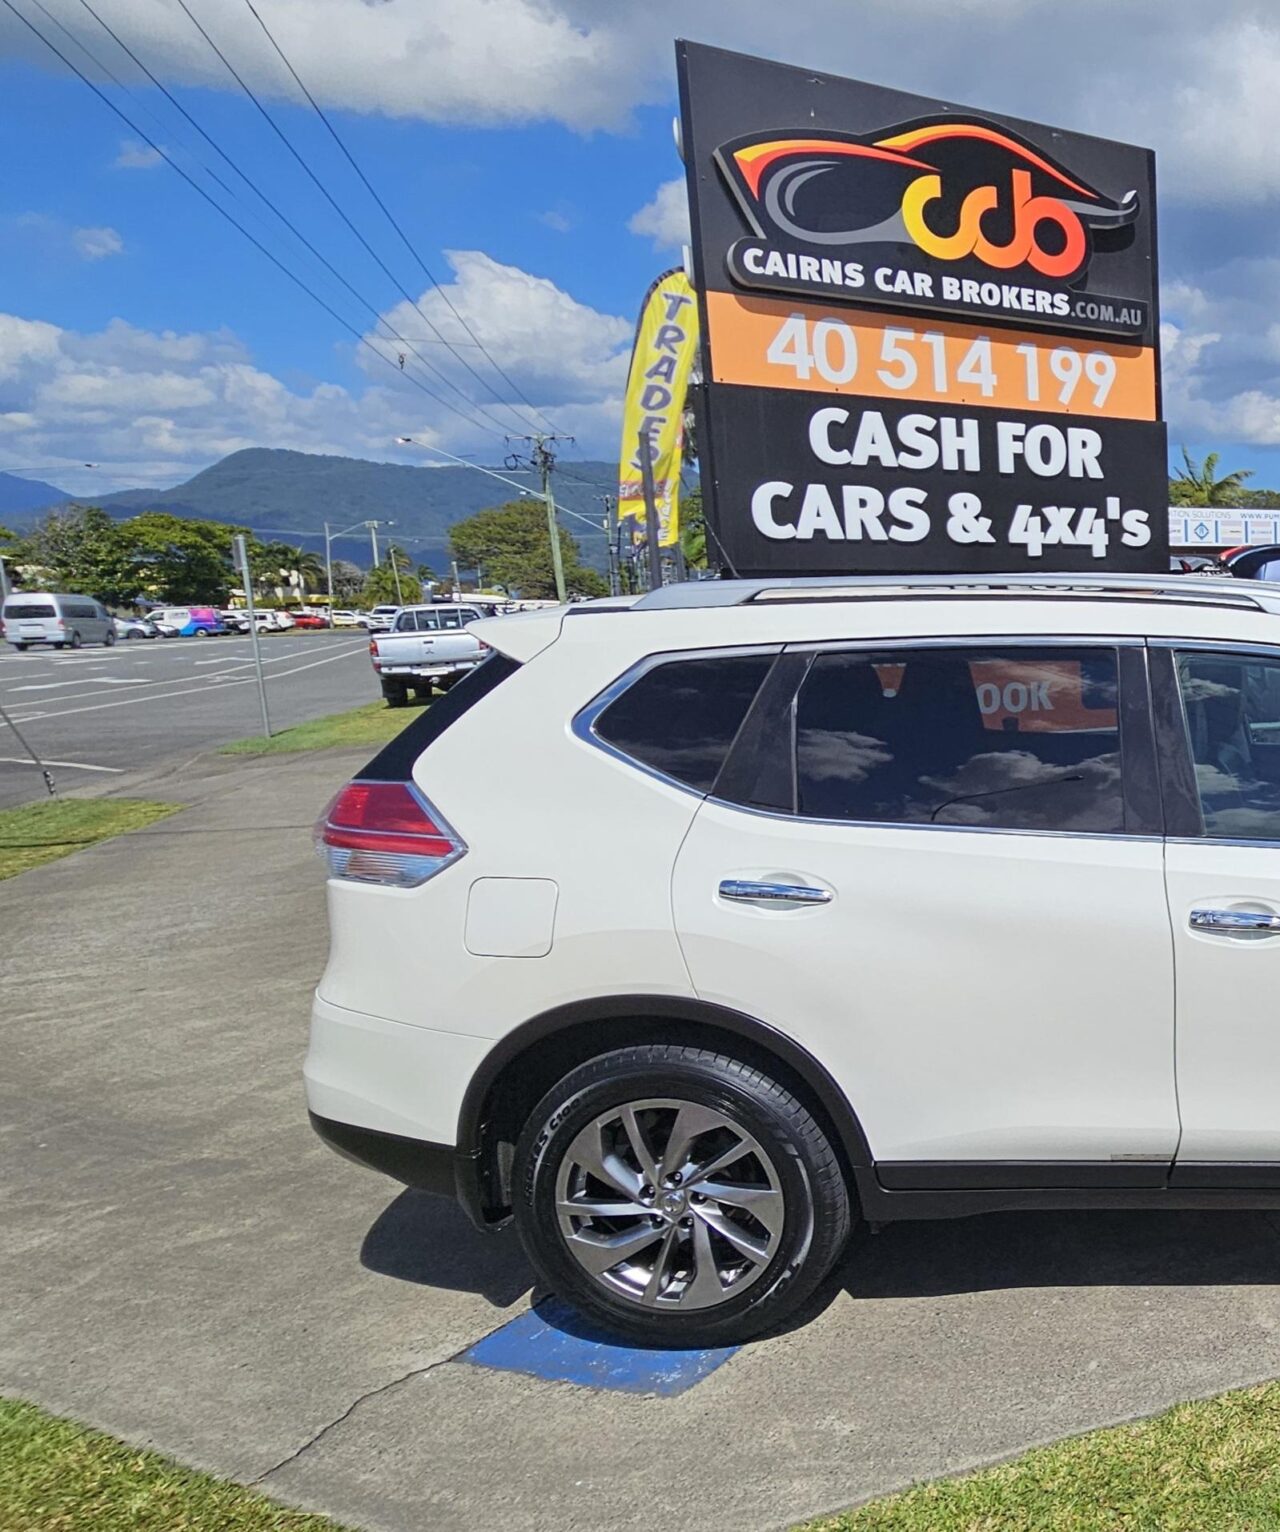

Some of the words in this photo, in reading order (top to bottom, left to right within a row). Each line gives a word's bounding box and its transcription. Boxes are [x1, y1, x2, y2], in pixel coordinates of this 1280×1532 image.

[742, 246, 864, 288] CAIRNS
[874, 267, 934, 298] CAR
[631, 293, 692, 472] TRADES
[766, 313, 858, 385] 40
[877, 326, 997, 398] 514
[1016, 343, 1116, 408] 199
[808, 406, 980, 472] CASH
[997, 420, 1104, 479] FOR
[751, 480, 930, 543] CARS
[946, 492, 996, 544] &
[1192, 511, 1231, 520] SOLUTIONS
[549, 1098, 581, 1131] C100
